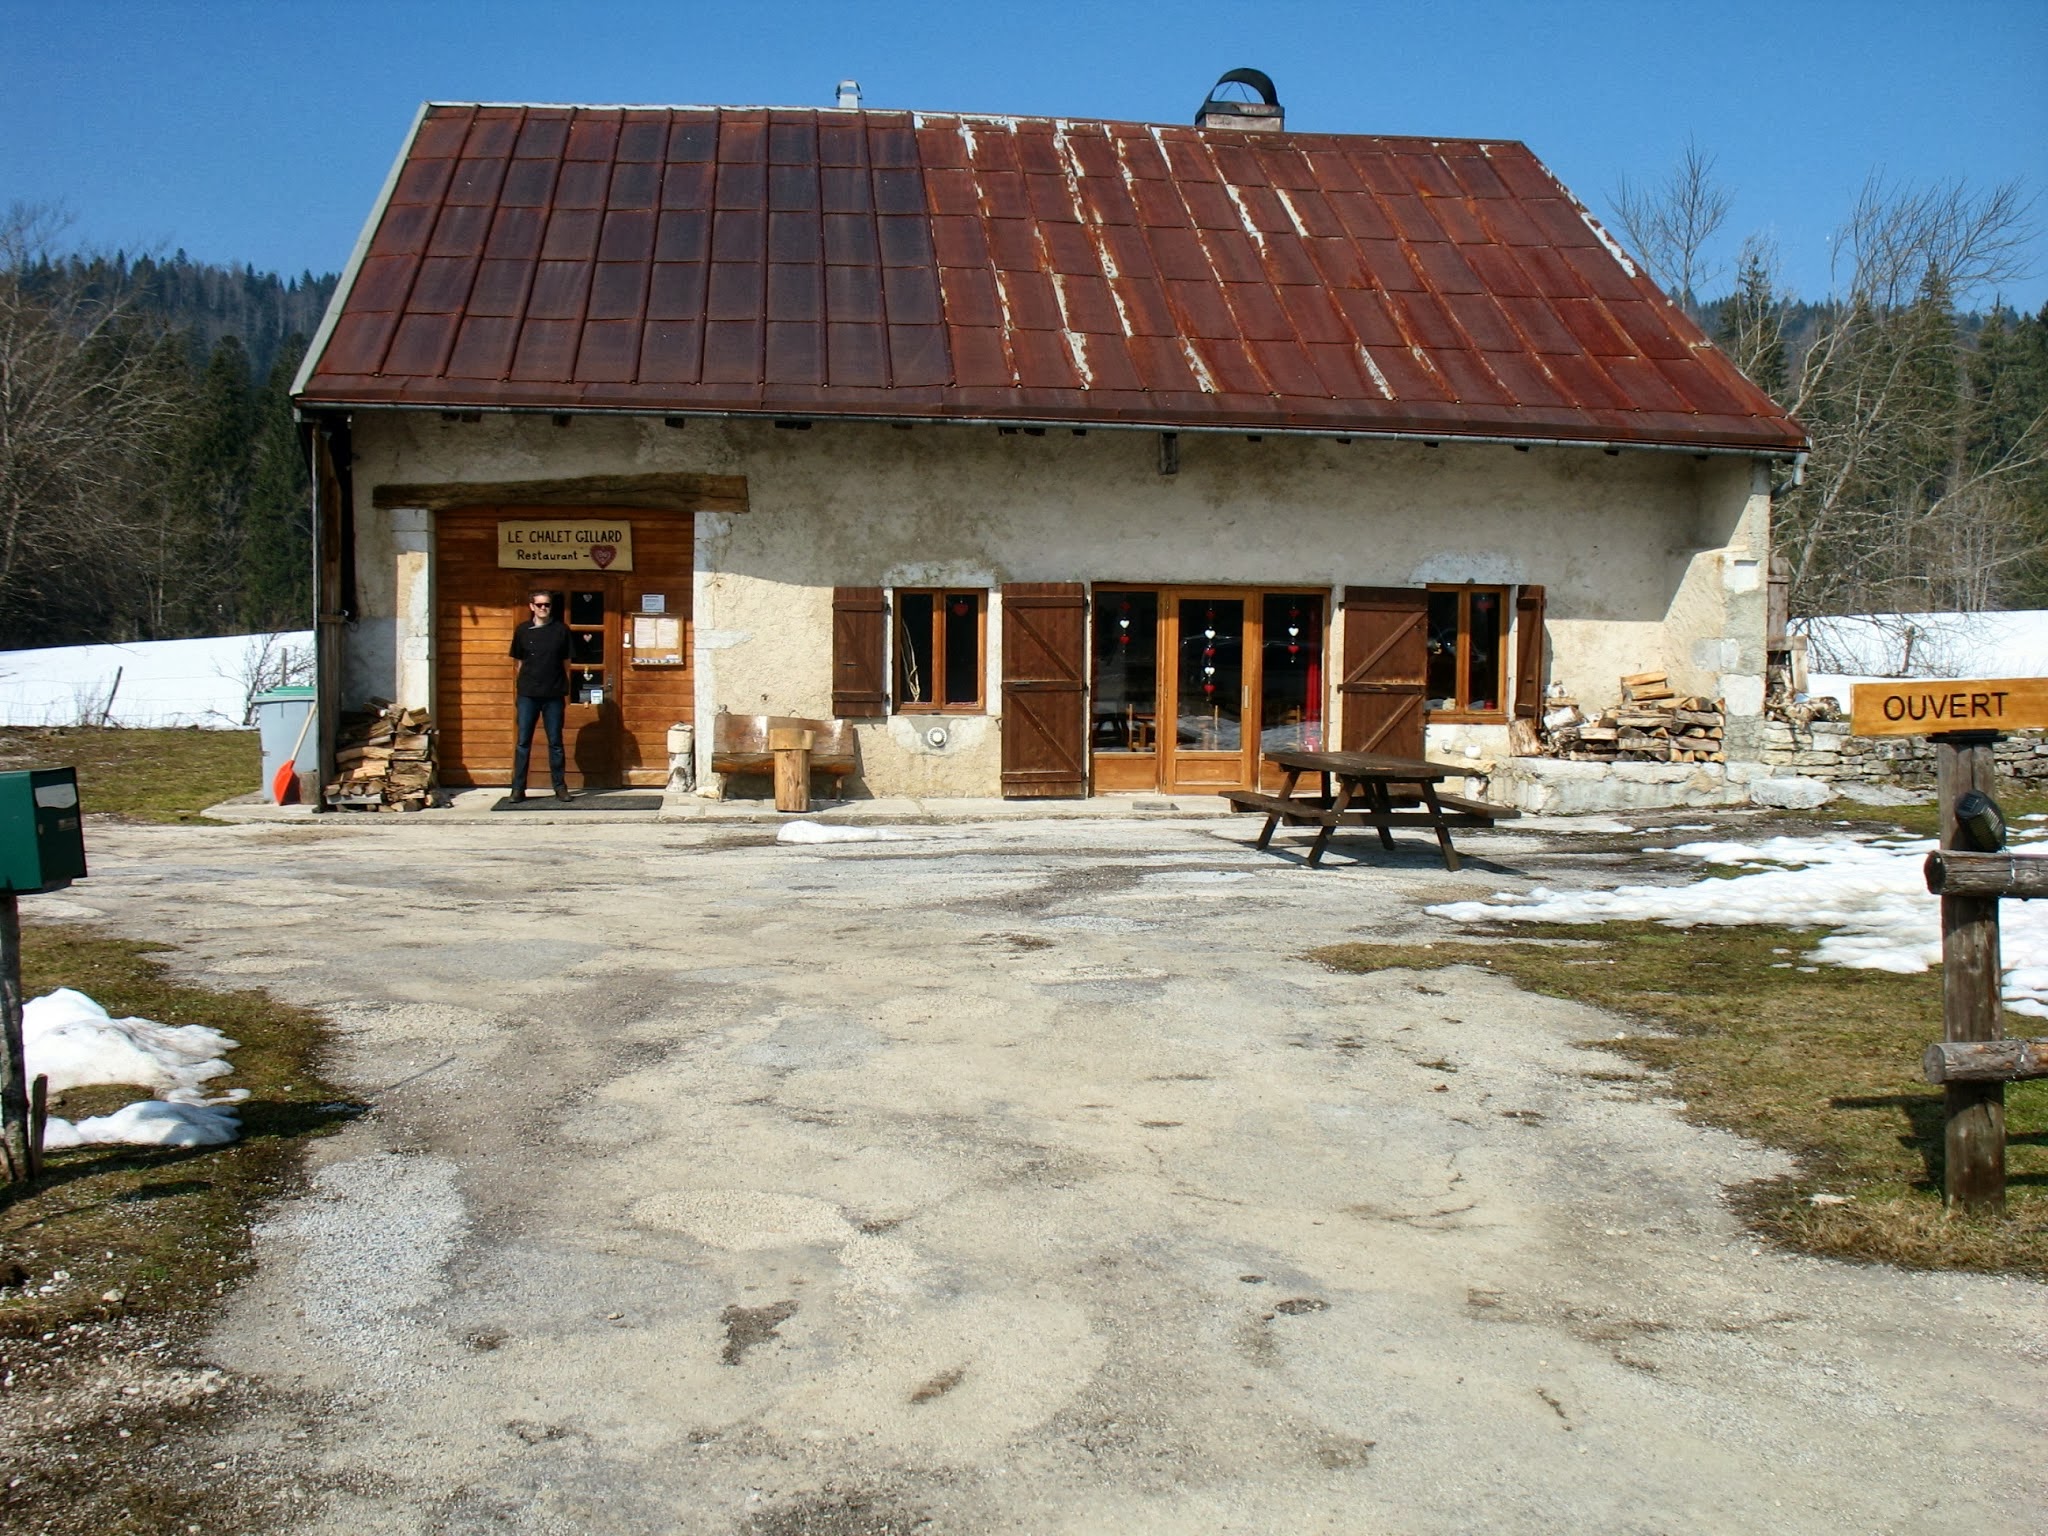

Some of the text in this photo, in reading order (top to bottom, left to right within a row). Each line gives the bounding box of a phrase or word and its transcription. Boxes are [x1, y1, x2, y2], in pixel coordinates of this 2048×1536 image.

[507, 530, 622, 543] LE CHALET GILLARD
[517, 549, 578, 561] Restaurant
[1883, 692, 2009, 721] OUVERT
